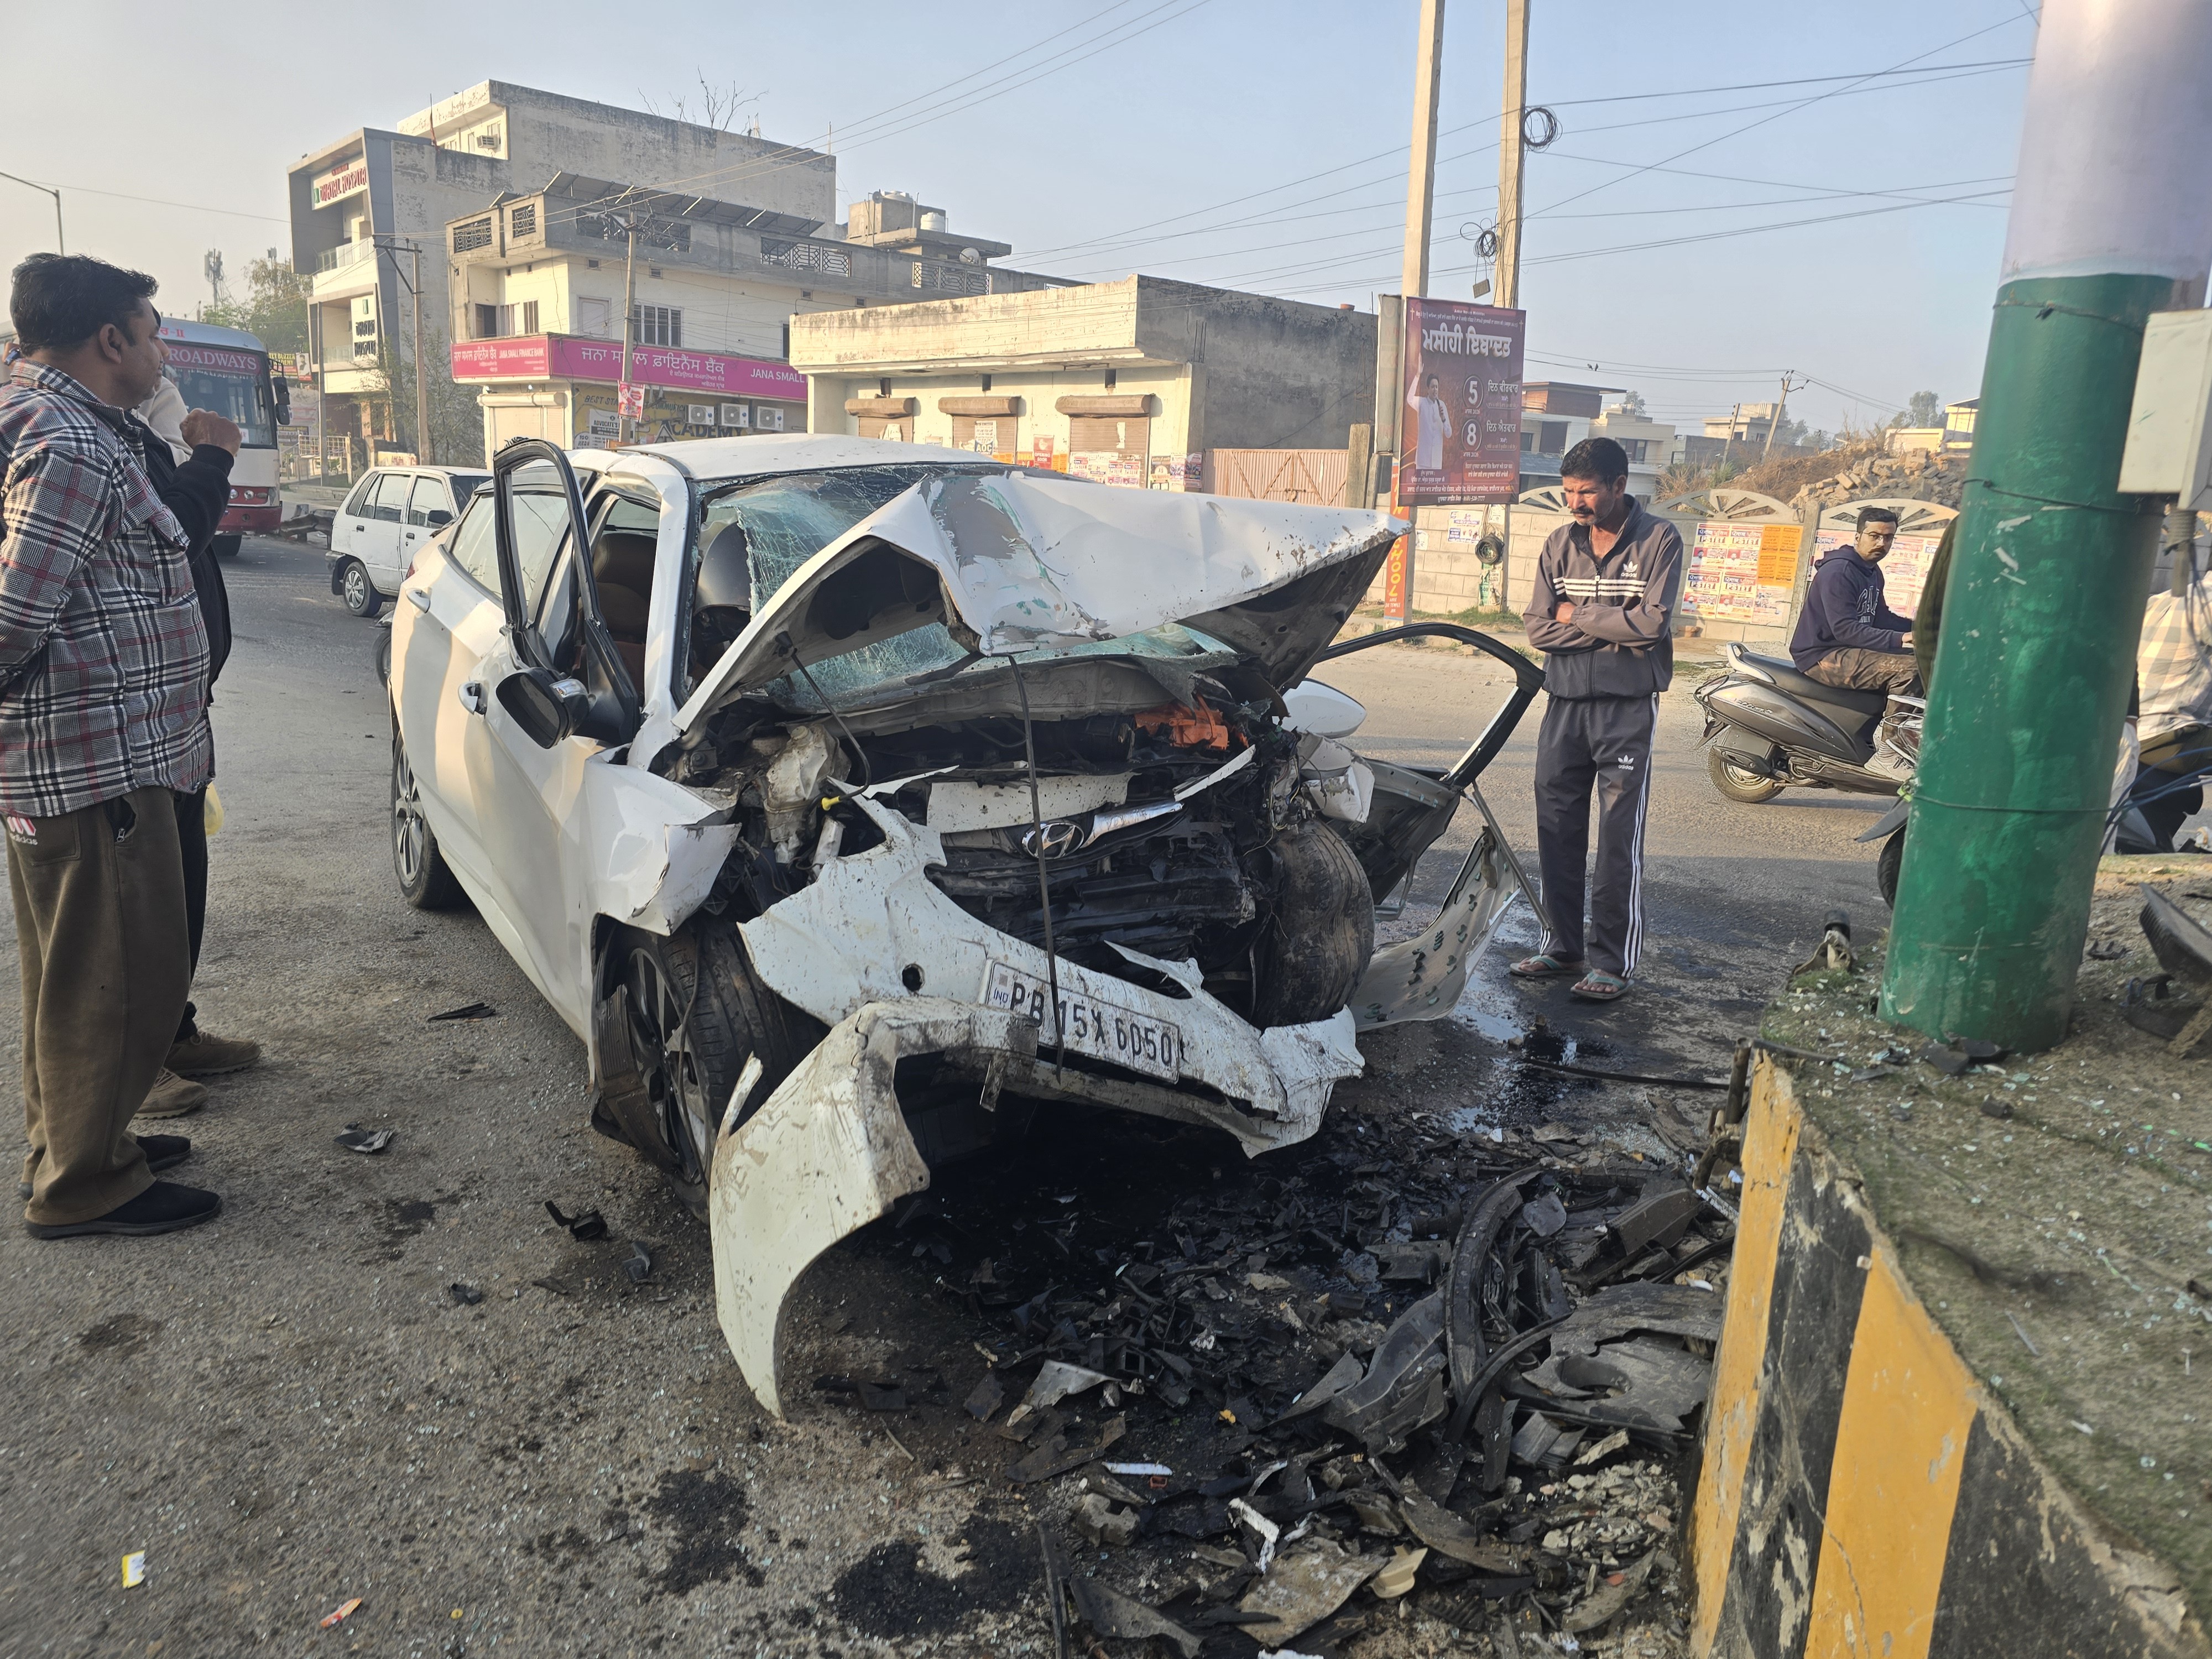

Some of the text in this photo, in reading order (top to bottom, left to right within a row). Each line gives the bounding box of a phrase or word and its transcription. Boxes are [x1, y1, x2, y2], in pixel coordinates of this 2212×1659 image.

[342, 166, 367, 194] HOSPITA
[1422, 322, 1512, 358] ਮਸੀਹੀ ਇਬਾਦਤ
[169, 348, 257, 370] ROADWAYS
[499, 348, 544, 358] JANA SMALL FINANCE BANK
[581, 347, 607, 361] ਜਨਾ
[611, 350, 648, 366] ਸਾਲ
[705, 357, 725, 374] ਬੈਂਕ
[750, 368, 805, 383] JANA SMALL
[1488, 379, 1519, 393] ਦਿਨ ਵੀਰਵਾਰ
[585, 395, 604, 403] BEST
[1468, 380, 1478, 405] 5
[1467, 424, 1477, 446] 8
[1486, 419, 1516, 432] ਦਿਨ ਐਤਵਾਰ
[1389, 537, 1404, 597] CHOOL
[994, 989, 1008, 1004] IND
[1010, 981, 1045, 1027] PB
[1115, 1018, 1172, 1067] 6050
